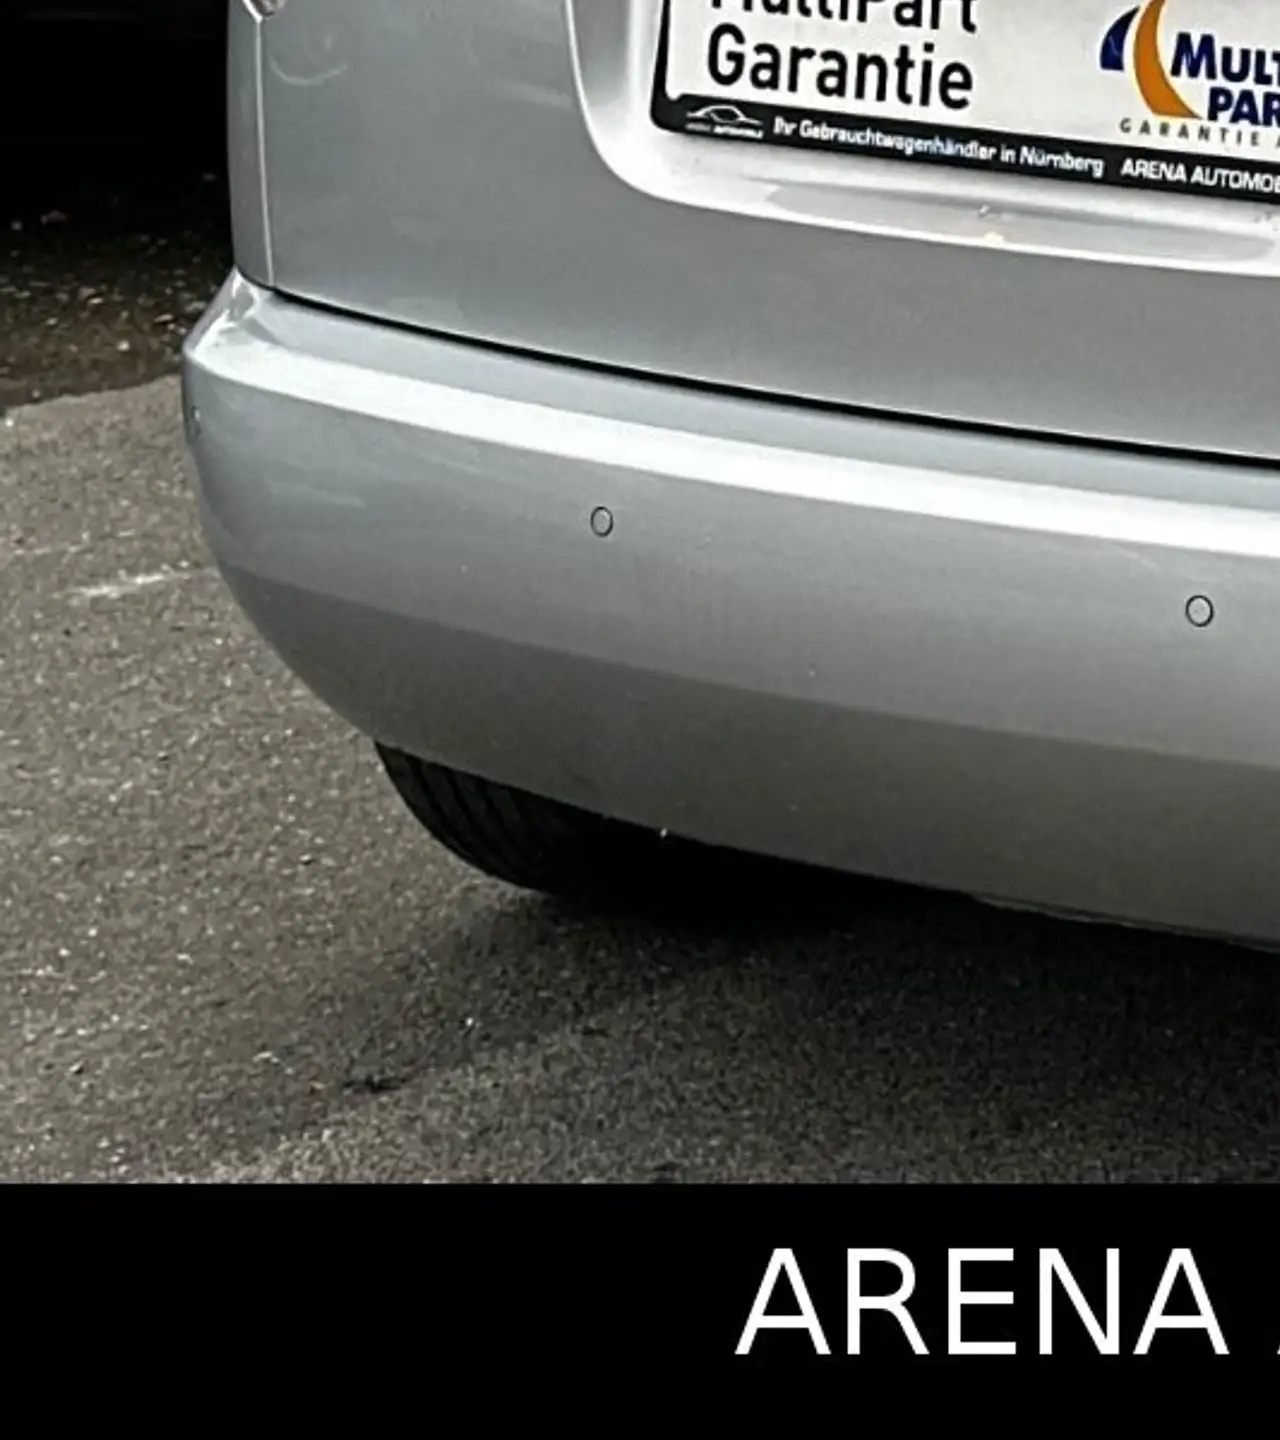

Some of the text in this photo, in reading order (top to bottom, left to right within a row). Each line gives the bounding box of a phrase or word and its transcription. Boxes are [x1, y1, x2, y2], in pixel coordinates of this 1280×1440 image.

[707, 22, 974, 110] Garantie
[774, 116, 798, 136] Ihr
[799, 119, 997, 160] Gebrauchtwagenhändler
[1000, 145, 1015, 163] in
[1019, 146, 1105, 177] Nürnberg
[1119, 118, 1260, 148] GARANTIE
[1121, 159, 1188, 184] ARENA
